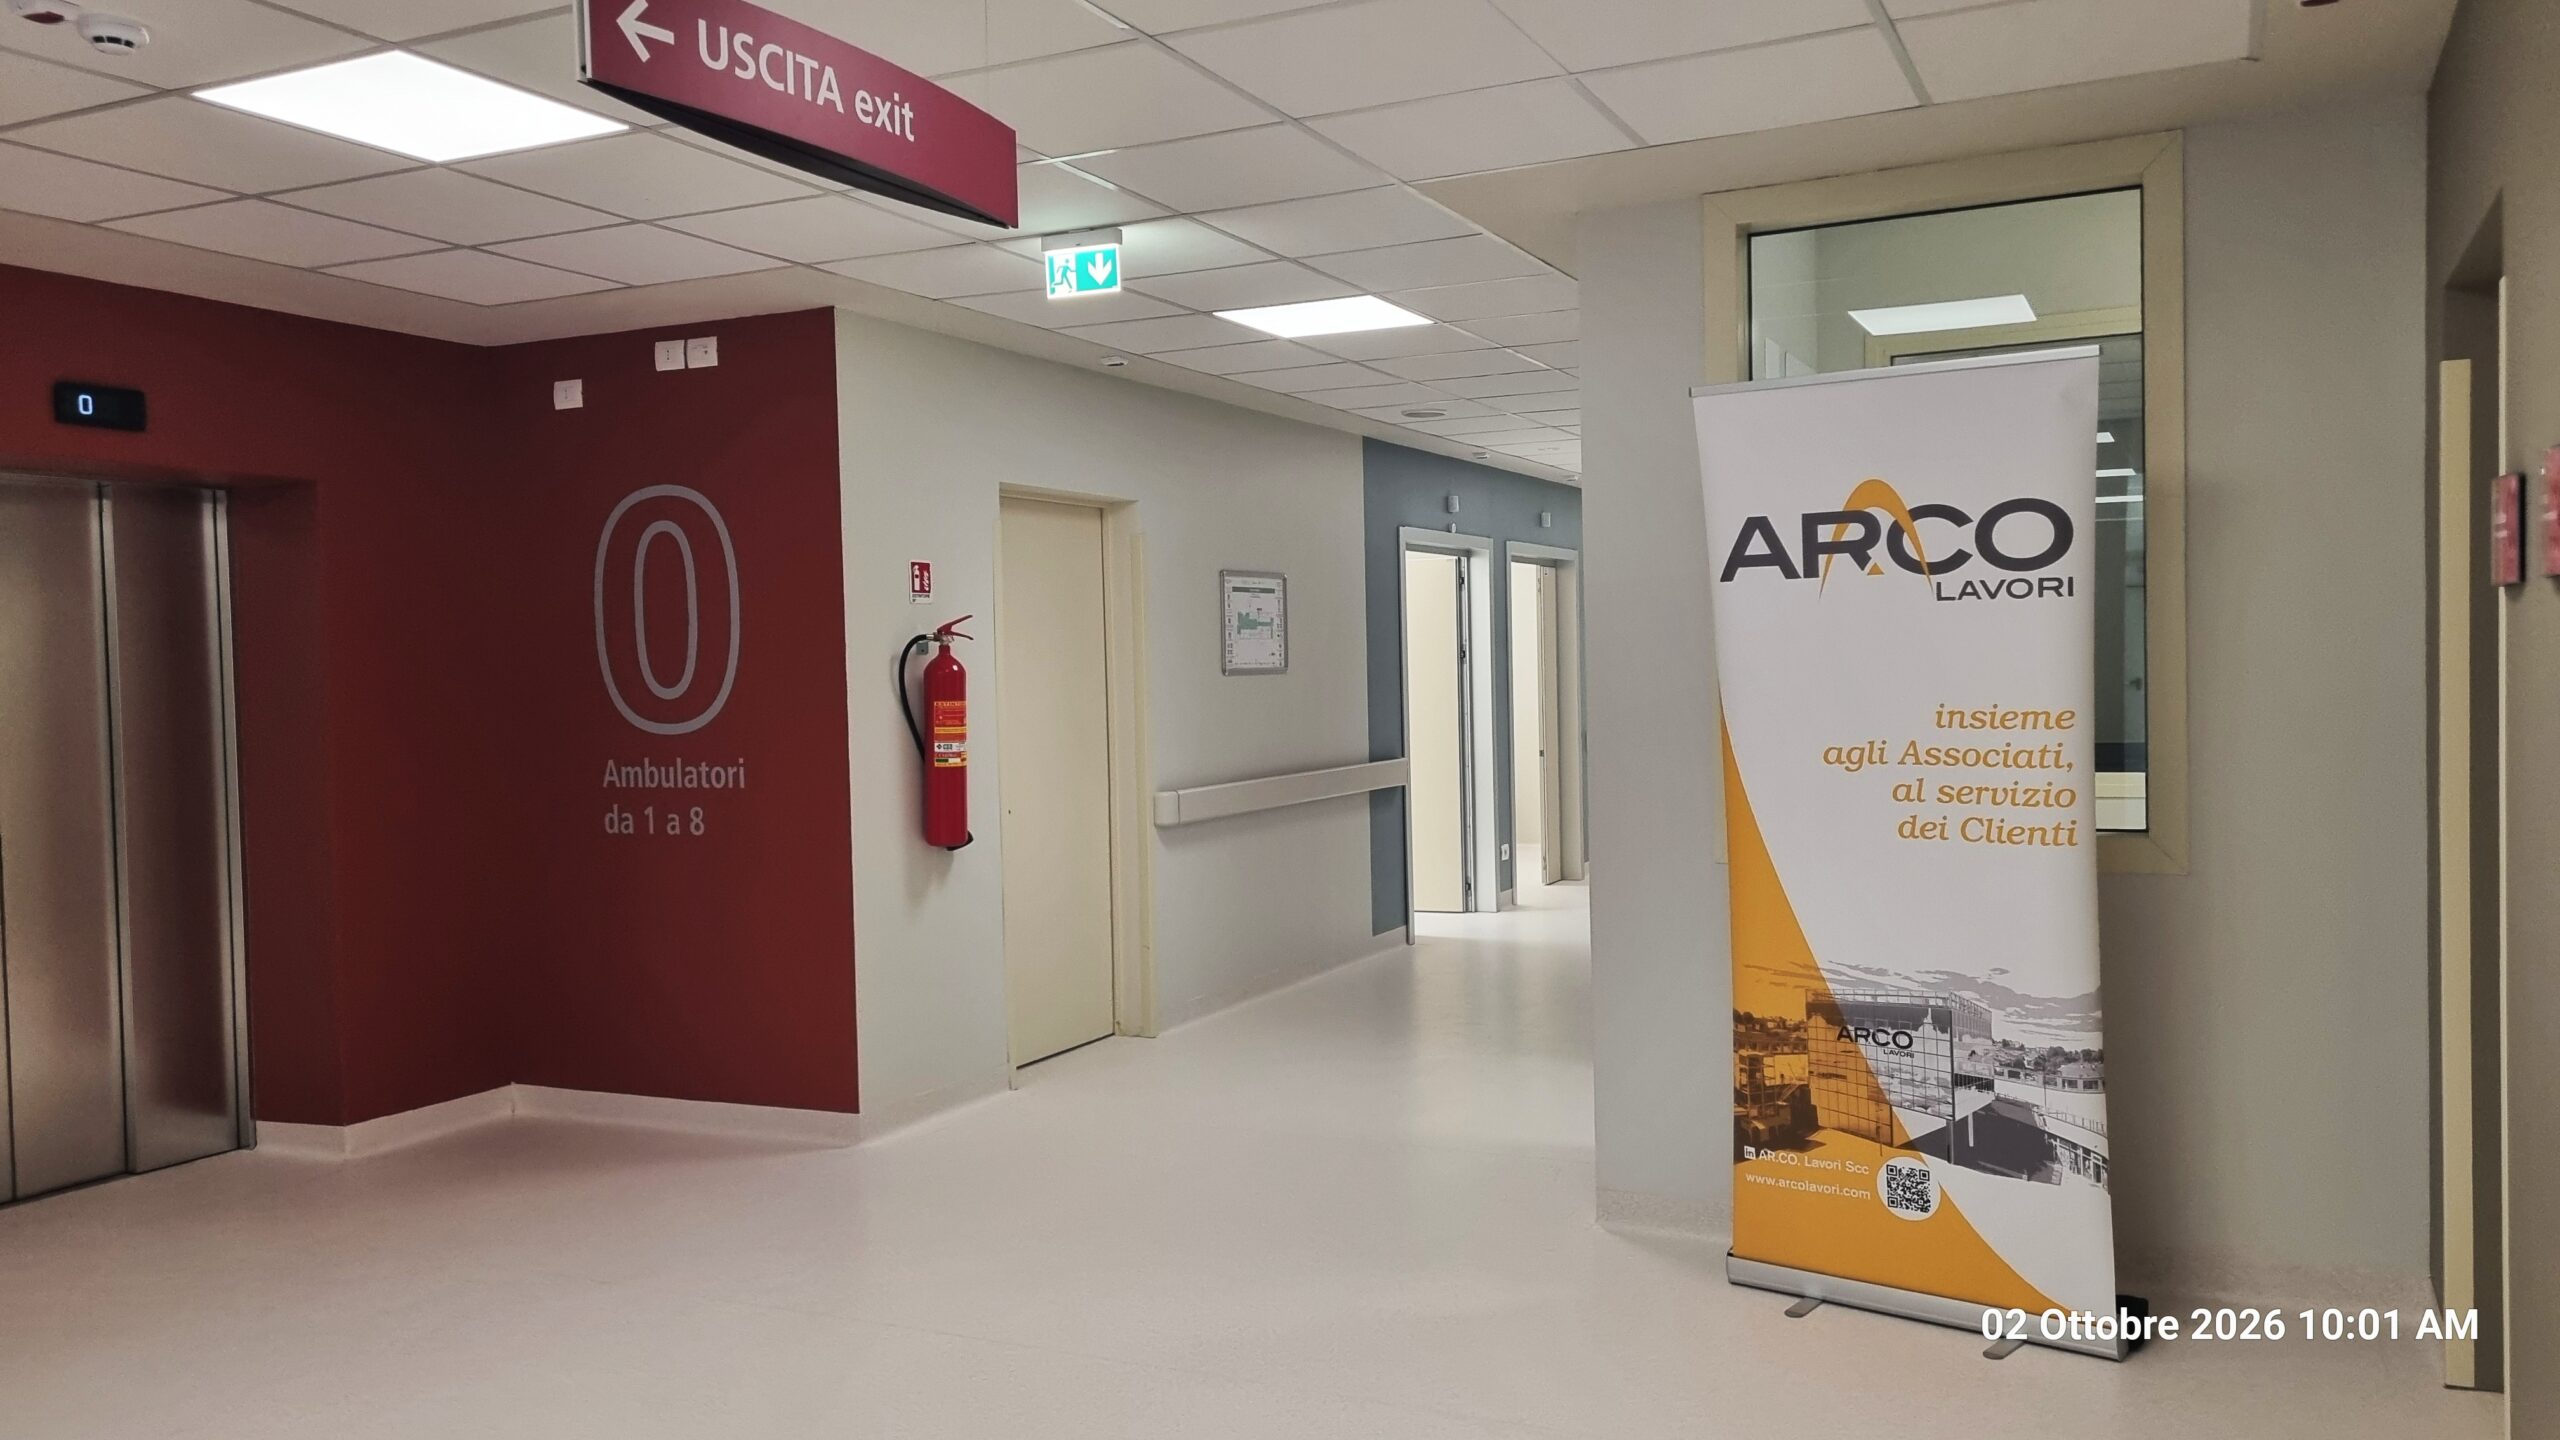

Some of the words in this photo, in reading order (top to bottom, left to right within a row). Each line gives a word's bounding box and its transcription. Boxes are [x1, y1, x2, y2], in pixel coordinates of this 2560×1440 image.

[698, 18, 844, 114] USCITA
[855, 89, 915, 142] exit
[78, 394, 93, 415] 0
[1720, 497, 2074, 583] ARCO
[1936, 576, 2074, 601] LAVORI
[594, 484, 740, 735] 0
[1935, 703, 2076, 730] insieme
[1823, 739, 1888, 772] agli
[1897, 740, 2074, 772] Associati,
[603, 758, 745, 789] Ambulatori
[1892, 778, 1926, 802] al
[1936, 780, 2077, 808] servizio
[604, 804, 634, 834] da
[644, 806, 654, 834] 1
[666, 813, 681, 835] a
[689, 806, 705, 836] 8
[1898, 814, 1949, 840] dei
[1960, 816, 2078, 847] Clienti
[1837, 1025, 1914, 1050] ARCO
[1883, 1048, 1915, 1058] LAVORI
[1758, 1150, 1801, 1166] AR.CO.
[1804, 1156, 1841, 1171] Lavori
[1845, 1161, 1870, 1176] Scc
[1745, 1172, 1871, 1200] www.arcolavori.com
